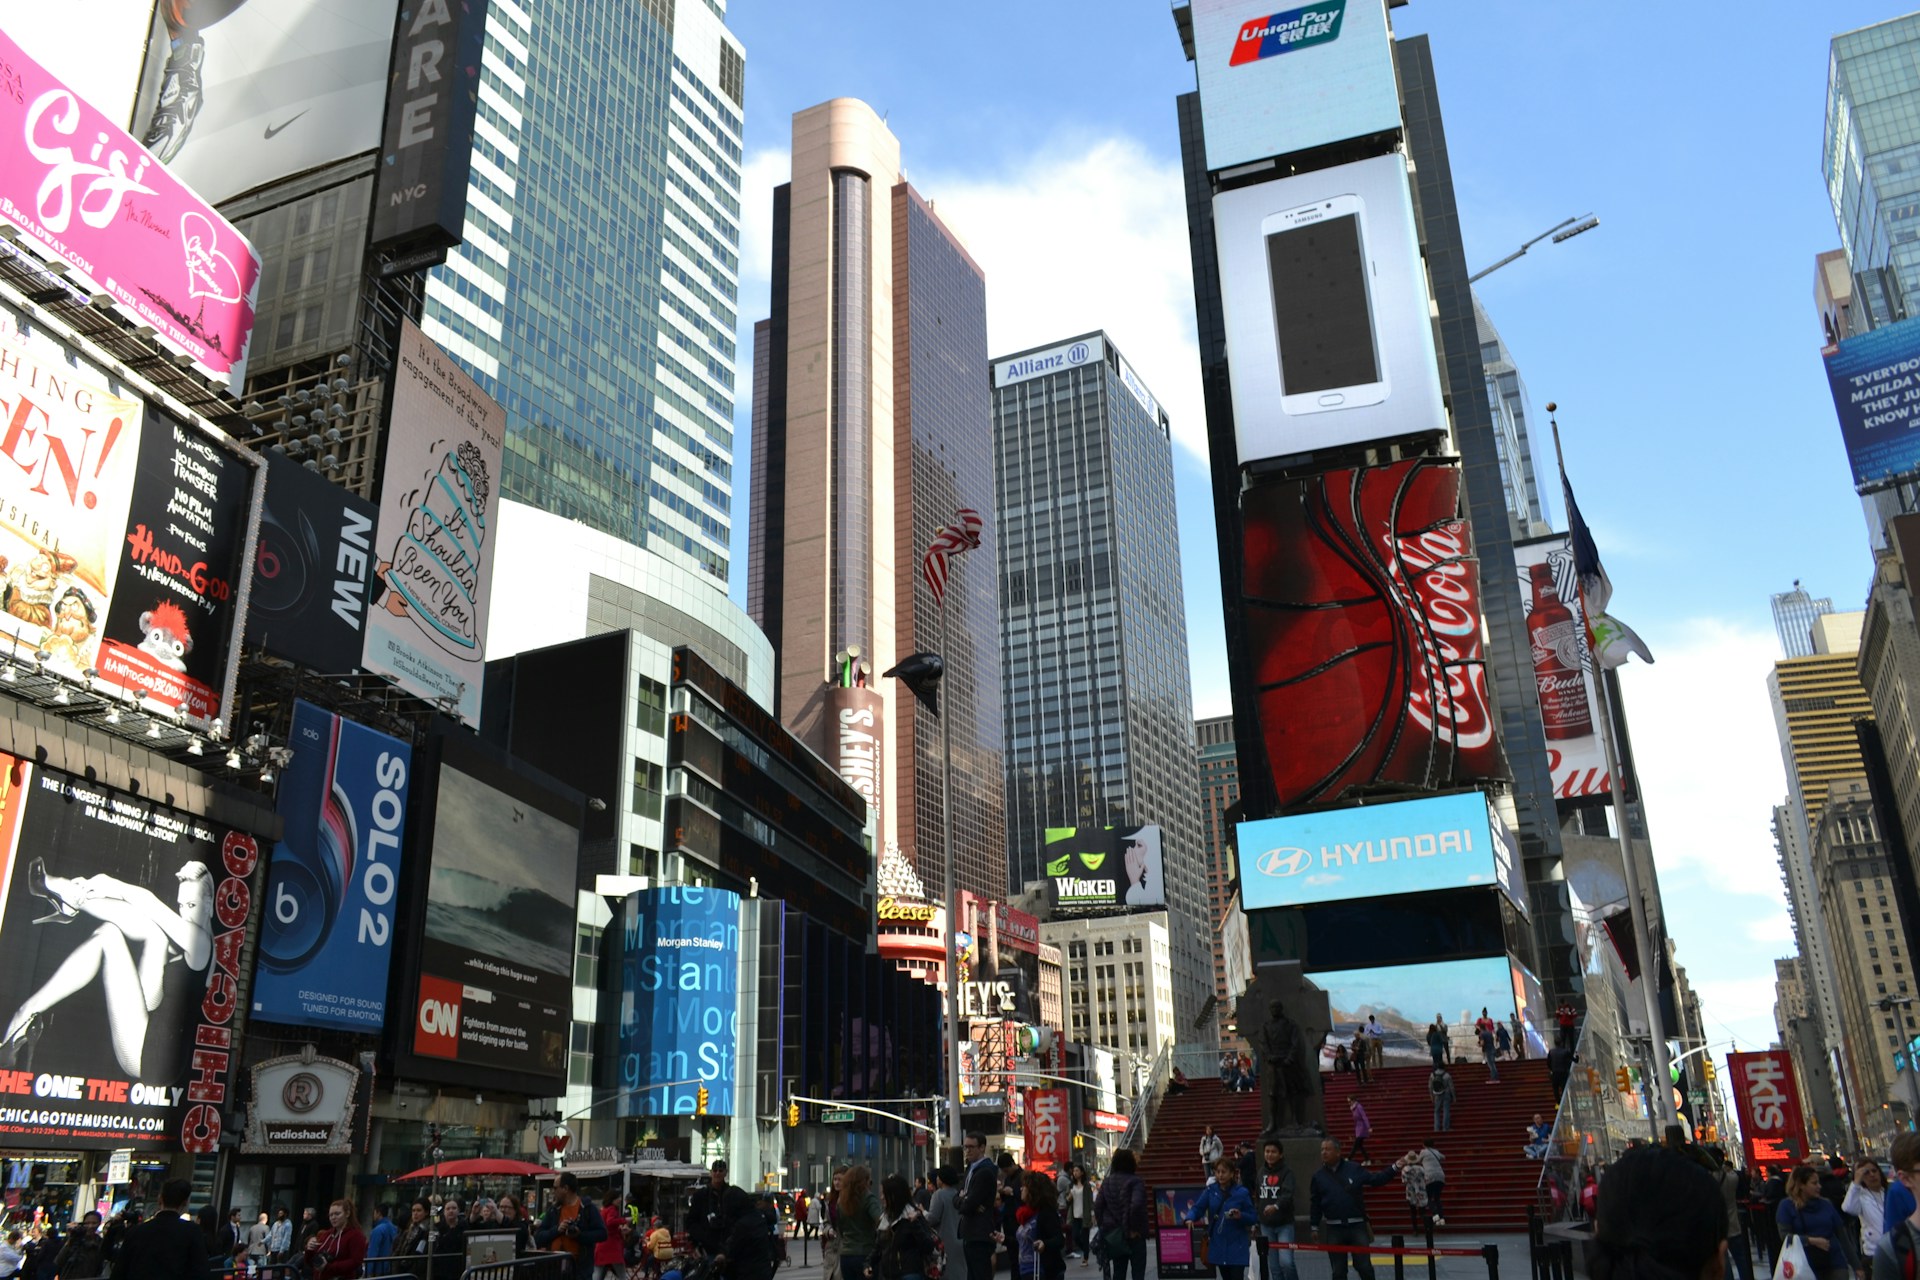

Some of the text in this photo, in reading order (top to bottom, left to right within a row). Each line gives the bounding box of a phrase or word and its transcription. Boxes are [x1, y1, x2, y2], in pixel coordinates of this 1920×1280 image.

[1240, 9, 1340, 42] UnionPay
[391, 184, 427, 207] NYC
[116, 286, 206, 360] NEIL SIMON THEATRE
[418, 343, 488, 422] It's the Broadway
[1007, 353, 1064, 379] Allianz
[402, 355, 454, 410] engagement
[456, 403, 465, 419] of
[466, 411, 479, 431] the
[1851, 378, 1913, 403] MATILDA
[1861, 394, 1900, 414] THEY
[1864, 406, 1910, 429] KNOW
[187, 456, 218, 485] LONDON
[174, 487, 213, 522] NO FILM
[127, 523, 182, 576] HAND
[190, 561, 230, 600] GOD
[331, 506, 373, 631] NEW
[411, 511, 477, 606] Shoulda
[147, 566, 171, 588] NEW
[197, 592, 216, 616] PLAY
[397, 546, 472, 638] Been You
[395, 643, 445, 679] Brooks Atkinson
[302, 727, 319, 742] solo
[42, 777, 60, 793] THE
[142, 809, 183, 832] AMERICAN
[184, 823, 216, 844] MUSICAL
[85, 805, 178, 844] IN BROADWAY HISTORY
[357, 751, 407, 947] SOLO 2
[1320, 829, 1473, 868] HYUNDAI
[877, 896, 938, 921] Reese's
[657, 937, 724, 950] Morgan Stanley
[484, 963, 500, 976] riding
[500, 967, 511, 977] this
[510, 970, 524, 981] huge
[181, 829, 259, 1154] CHICAGO
[298, 990, 385, 1011] DESIGNED FOR SOUND.
[302, 1003, 384, 1022] TUNED FOR EMOTION.
[419, 998, 459, 1038] CNN
[463, 1016, 527, 1038] Fighters from around the
[462, 1031, 529, 1051] world signing up for battle
[35, 1073, 86, 1100] ONE
[86, 1078, 130, 1104] THE
[130, 1082, 185, 1107] ONLY
[1744, 1057, 1788, 1131] tkts
[0, 1107, 165, 1132] CHICAGOTHEMUSICAL.COM
[269, 1129, 328, 1140] radioshack
[1034, 1094, 1061, 1155] tkts
[1259, 1186, 1280, 1199] NY
[1261, 1174, 1268, 1186] I
